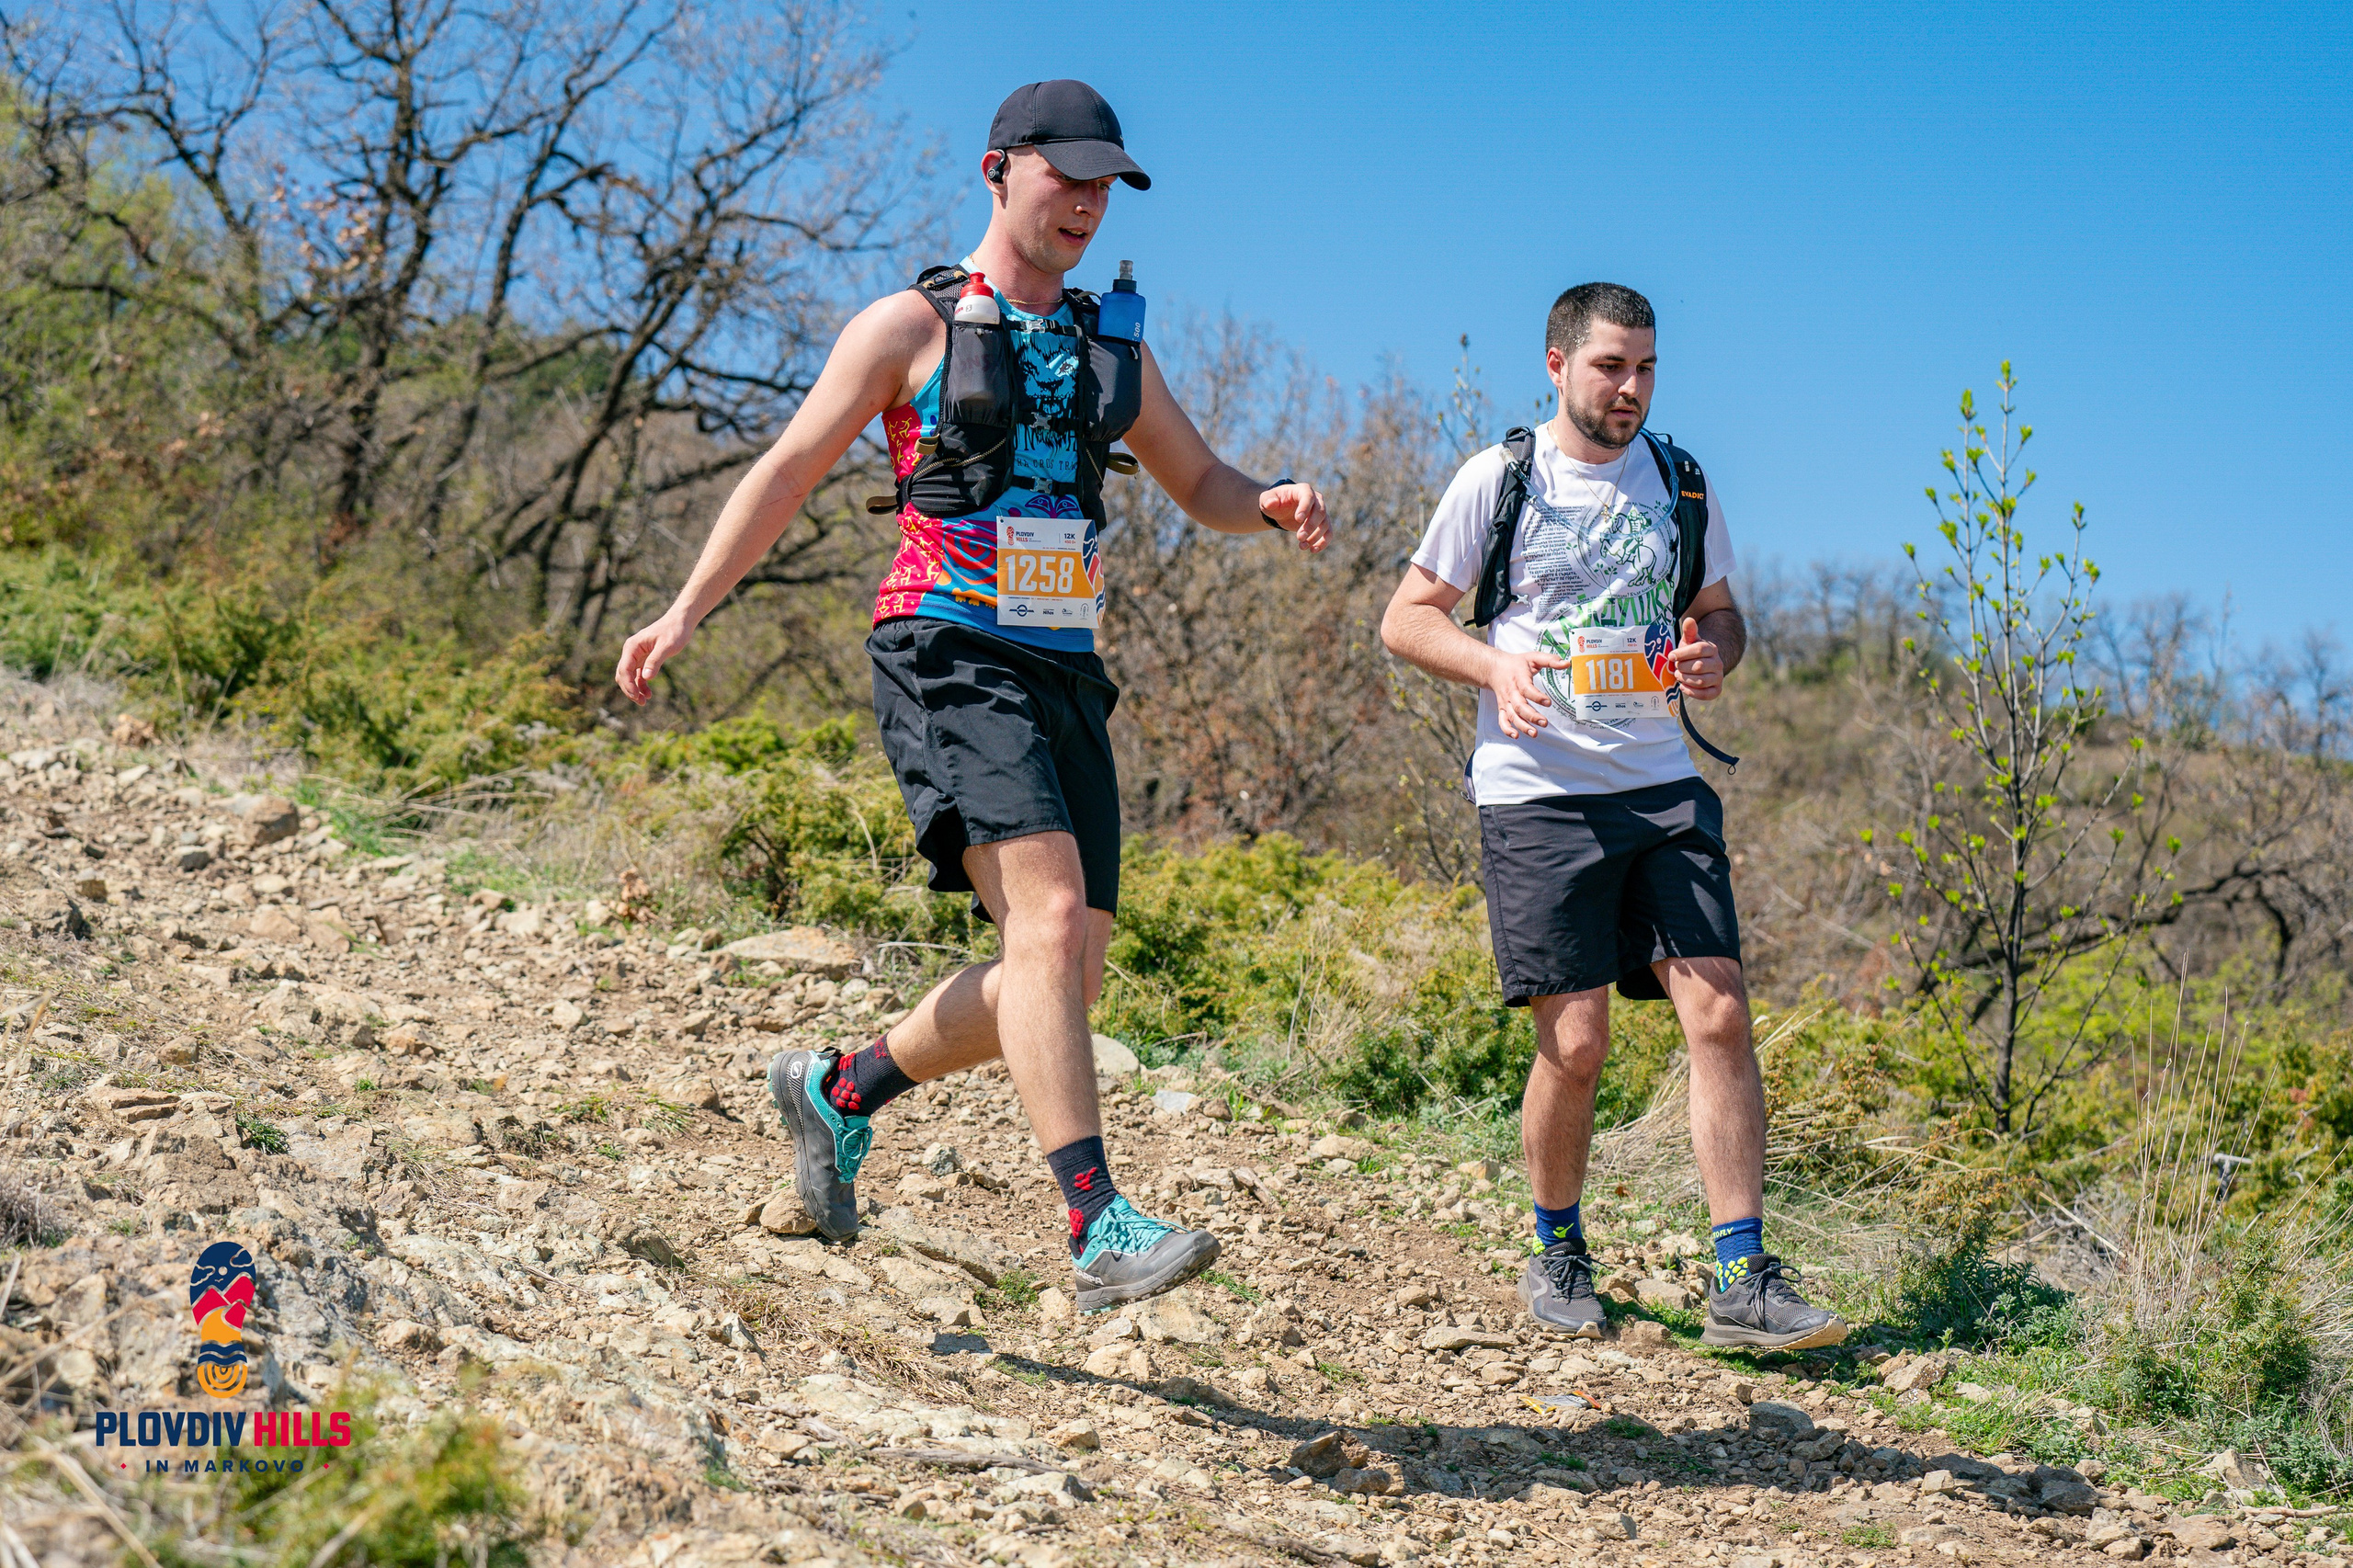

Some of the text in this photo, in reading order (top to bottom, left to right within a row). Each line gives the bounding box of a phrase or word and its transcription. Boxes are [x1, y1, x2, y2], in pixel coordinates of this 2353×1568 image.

[1681, 490, 1704, 500] EVADICT
[1005, 554, 1074, 594] 1258
[1586, 658, 1634, 690] 1181
[1720, 1227, 1733, 1237] FLY
